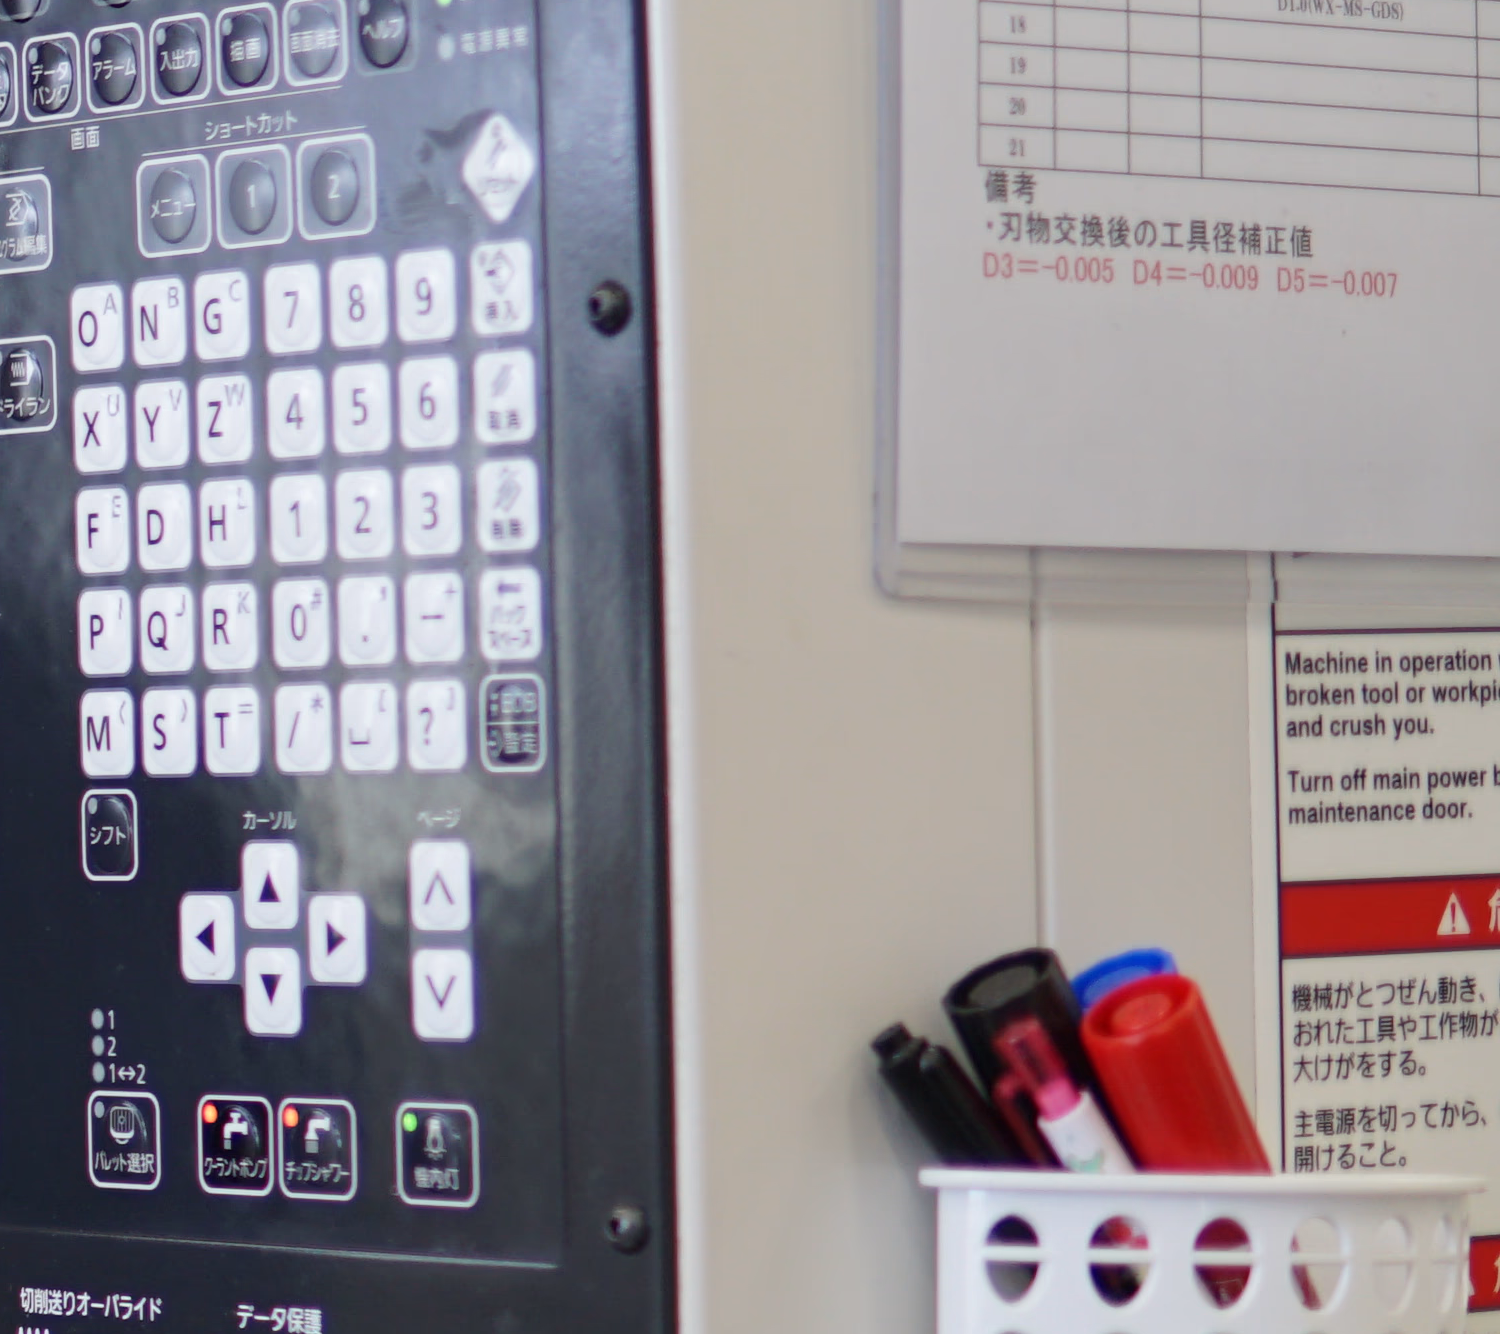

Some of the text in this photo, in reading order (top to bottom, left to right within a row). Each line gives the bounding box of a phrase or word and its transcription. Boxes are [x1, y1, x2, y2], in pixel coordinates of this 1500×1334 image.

[31, 60, 69, 85] データ
[92, 55, 136, 82] アラーム
[160, 47, 199, 71] 入出力
[32, 83, 70, 107] バンク
[71, 126, 100, 151] 画面
[205, 110, 298, 141] ショートカット
[247, 184, 257, 208] 1
[327, 173, 341, 200] 2
[985, 171, 1036, 204] 備考
[150, 199, 196, 218] メニュー
[283, 290, 300, 329] 7
[348, 284, 365, 322] 8
[414, 277, 433, 315] 9
[140, 304, 158, 341] N
[203, 298, 222, 334] G
[207, 400, 223, 437] Z
[286, 392, 303, 429] 4
[352, 387, 367, 425] 5
[419, 382, 435, 419] 6
[83, 411, 100, 447] X
[142, 406, 161, 442] Y
[146, 509, 164, 545] D
[209, 504, 226, 541] H
[289, 501, 301, 537] 1
[354, 496, 371, 534] 2
[421, 491, 437, 530] 3
[88, 513, 99, 549] F
[89, 615, 104, 650] P
[147, 611, 169, 651] Q
[213, 608, 230, 645] R
[1285, 650, 1491, 677] Machine in operation
[1286, 684, 1354, 706] broken
[1362, 682, 1398, 704] tool
[1406, 685, 1425, 704] or
[87, 716, 111, 752] M
[153, 714, 167, 750] S
[214, 712, 231, 749] T
[1287, 714, 1434, 740] and crush you.
[1287, 767, 1486, 795] Turn off main power
[242, 809, 297, 831] カーソル
[1288, 797, 1473, 825] maintenance door.
[89, 826, 127, 846] シフト
[1294, 1009, 1498, 1047] おれた工具や工作物が
[1294, 1050, 1426, 1082] 大けがをする。
[1294, 1101, 1487, 1138] 主電源を切ってから、
[95, 1152, 155, 1173] パレット選択
[204, 1157, 267, 1178] クーラントポンプ
[1294, 1140, 1406, 1172] 開けること。
[20, 1287, 162, 1322] 切削送りオーバライド
